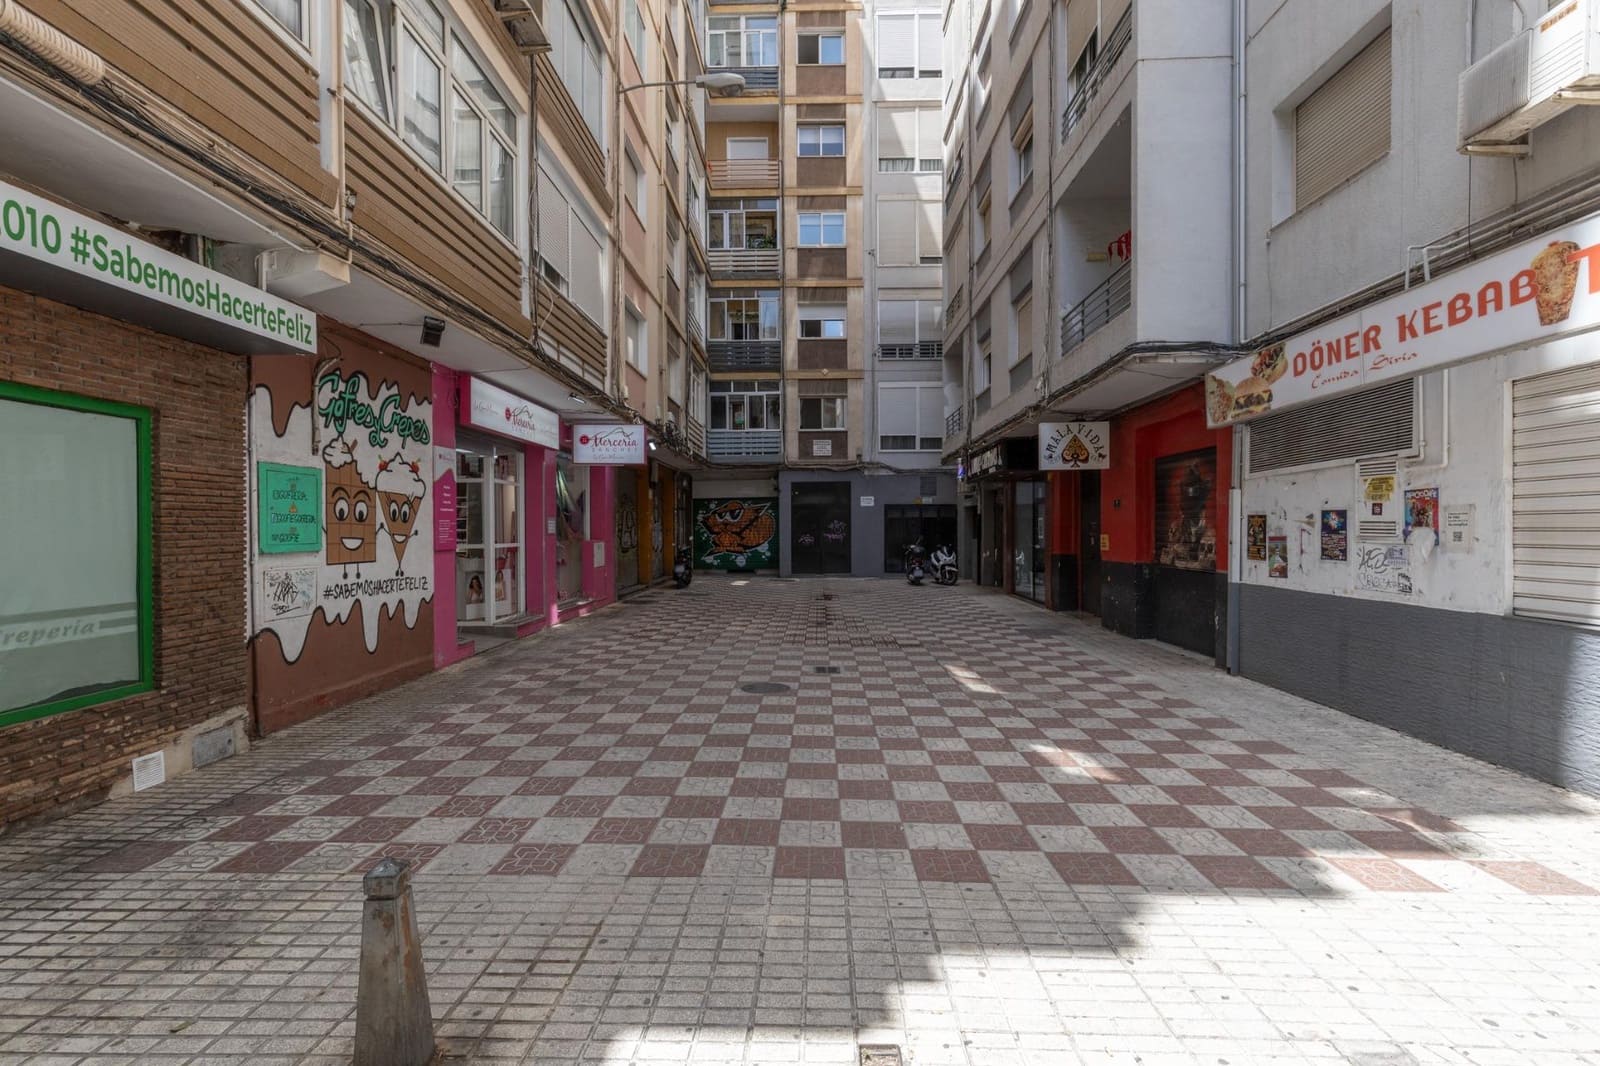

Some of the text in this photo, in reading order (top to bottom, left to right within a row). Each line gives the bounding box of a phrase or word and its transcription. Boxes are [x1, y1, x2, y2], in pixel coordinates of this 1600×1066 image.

[0, 200, 313, 346] 010 #SabemosHacerteFeliz
[1293, 325, 1381, 378] DÖNER
[1396, 268, 1538, 343] KEBAB
[318, 372, 374, 435] Gofres
[380, 395, 431, 449] Crepes
[1046, 423, 1105, 454] MALA VIDA
[323, 576, 428, 600] #SABEMOSHACERTEFELIZ
[0, 619, 95, 646] reperia
